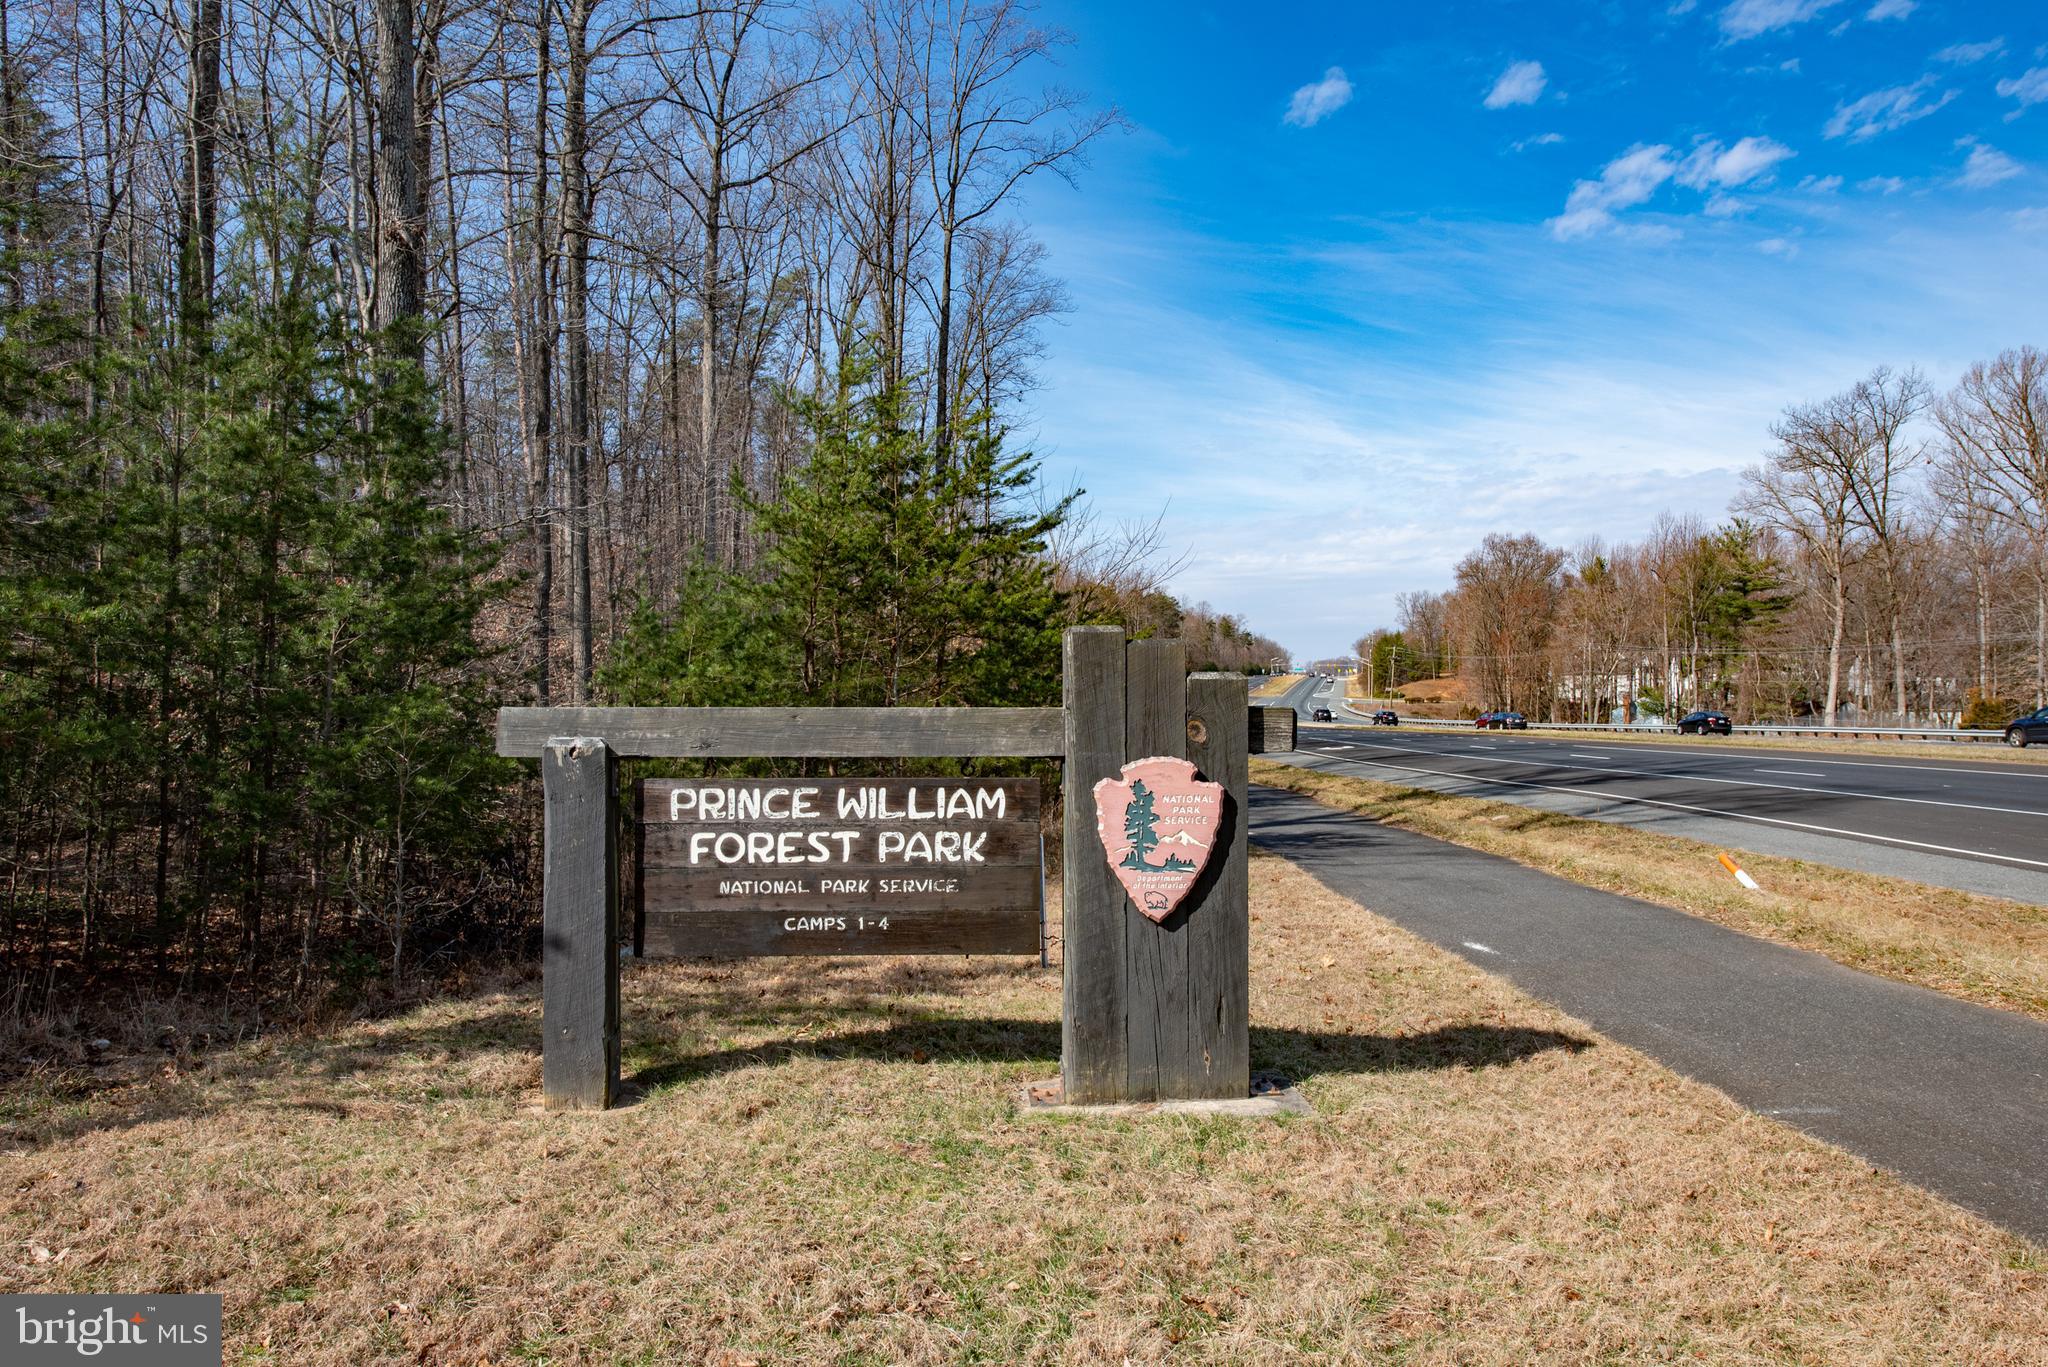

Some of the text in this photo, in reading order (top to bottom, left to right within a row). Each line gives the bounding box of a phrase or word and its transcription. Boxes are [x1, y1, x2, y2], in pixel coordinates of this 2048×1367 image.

[670, 786, 1006, 821] PRINCE WILLIAM
[1162, 795, 1215, 804] NATIONAL
[1172, 806, 1201, 815] PARK
[1164, 816, 1208, 825] SERVICE
[689, 830, 988, 865] FOREST PARK
[719, 878, 960, 895] NATIONAL PARK SERVICE
[784, 916, 890, 932] CAMPS 1-4
